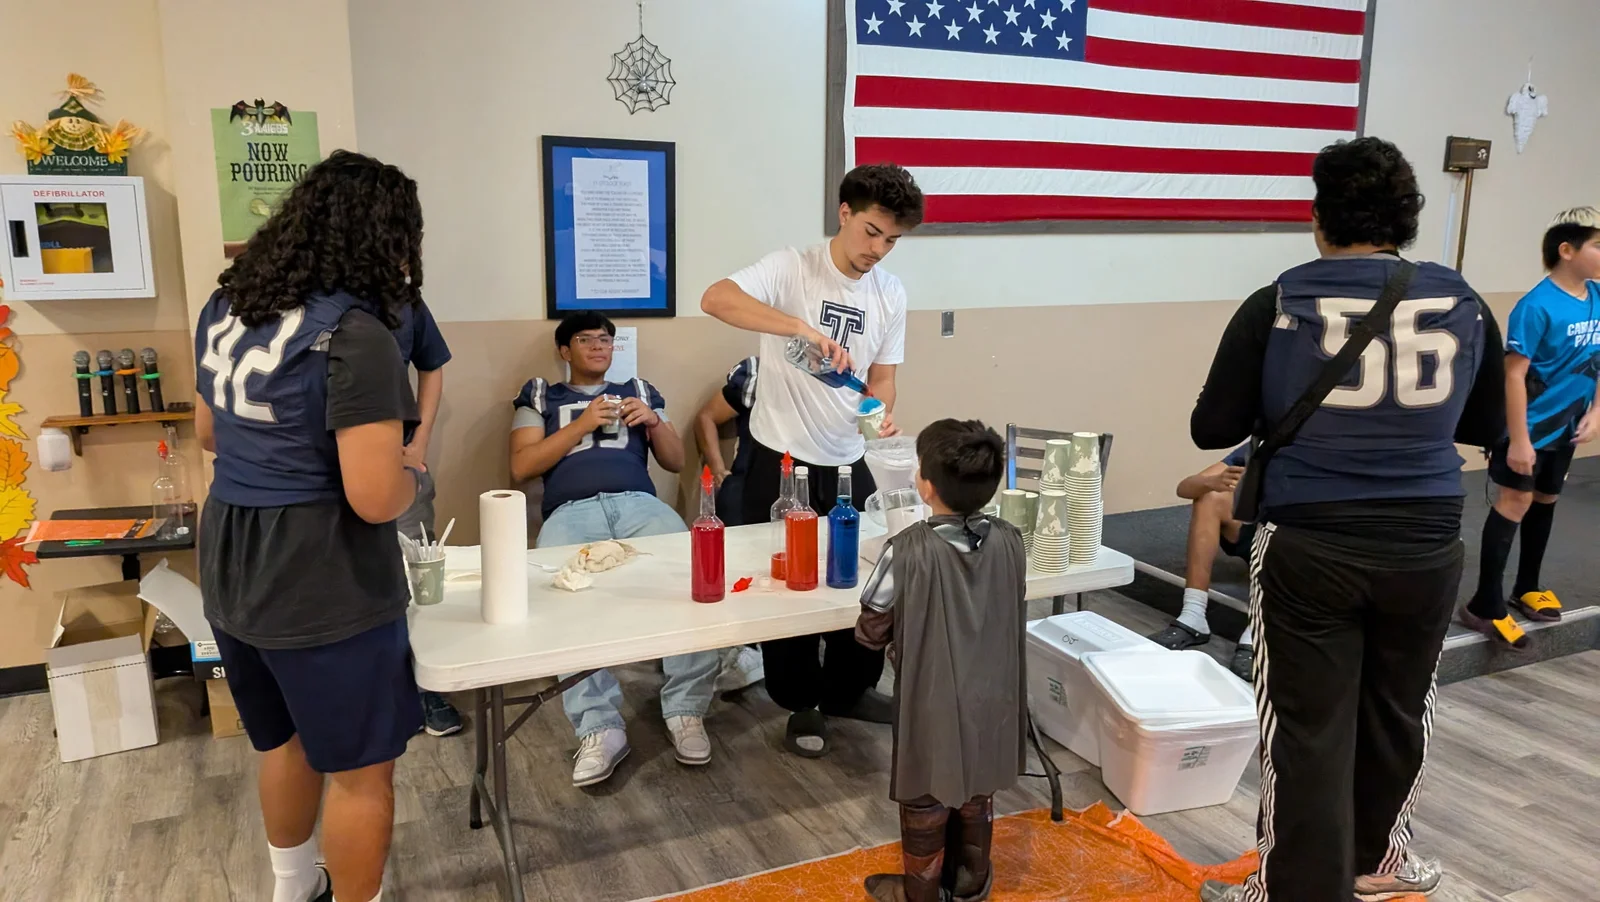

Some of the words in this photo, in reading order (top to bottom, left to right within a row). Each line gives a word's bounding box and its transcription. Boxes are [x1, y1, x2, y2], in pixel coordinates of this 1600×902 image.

[240, 121, 254, 136] 3
[41, 155, 109, 167] WELCOME
[247, 142, 288, 162] NOW
[820, 300, 866, 354] T
[200, 304, 305, 424] 42
[1315, 297, 1460, 410] 56
